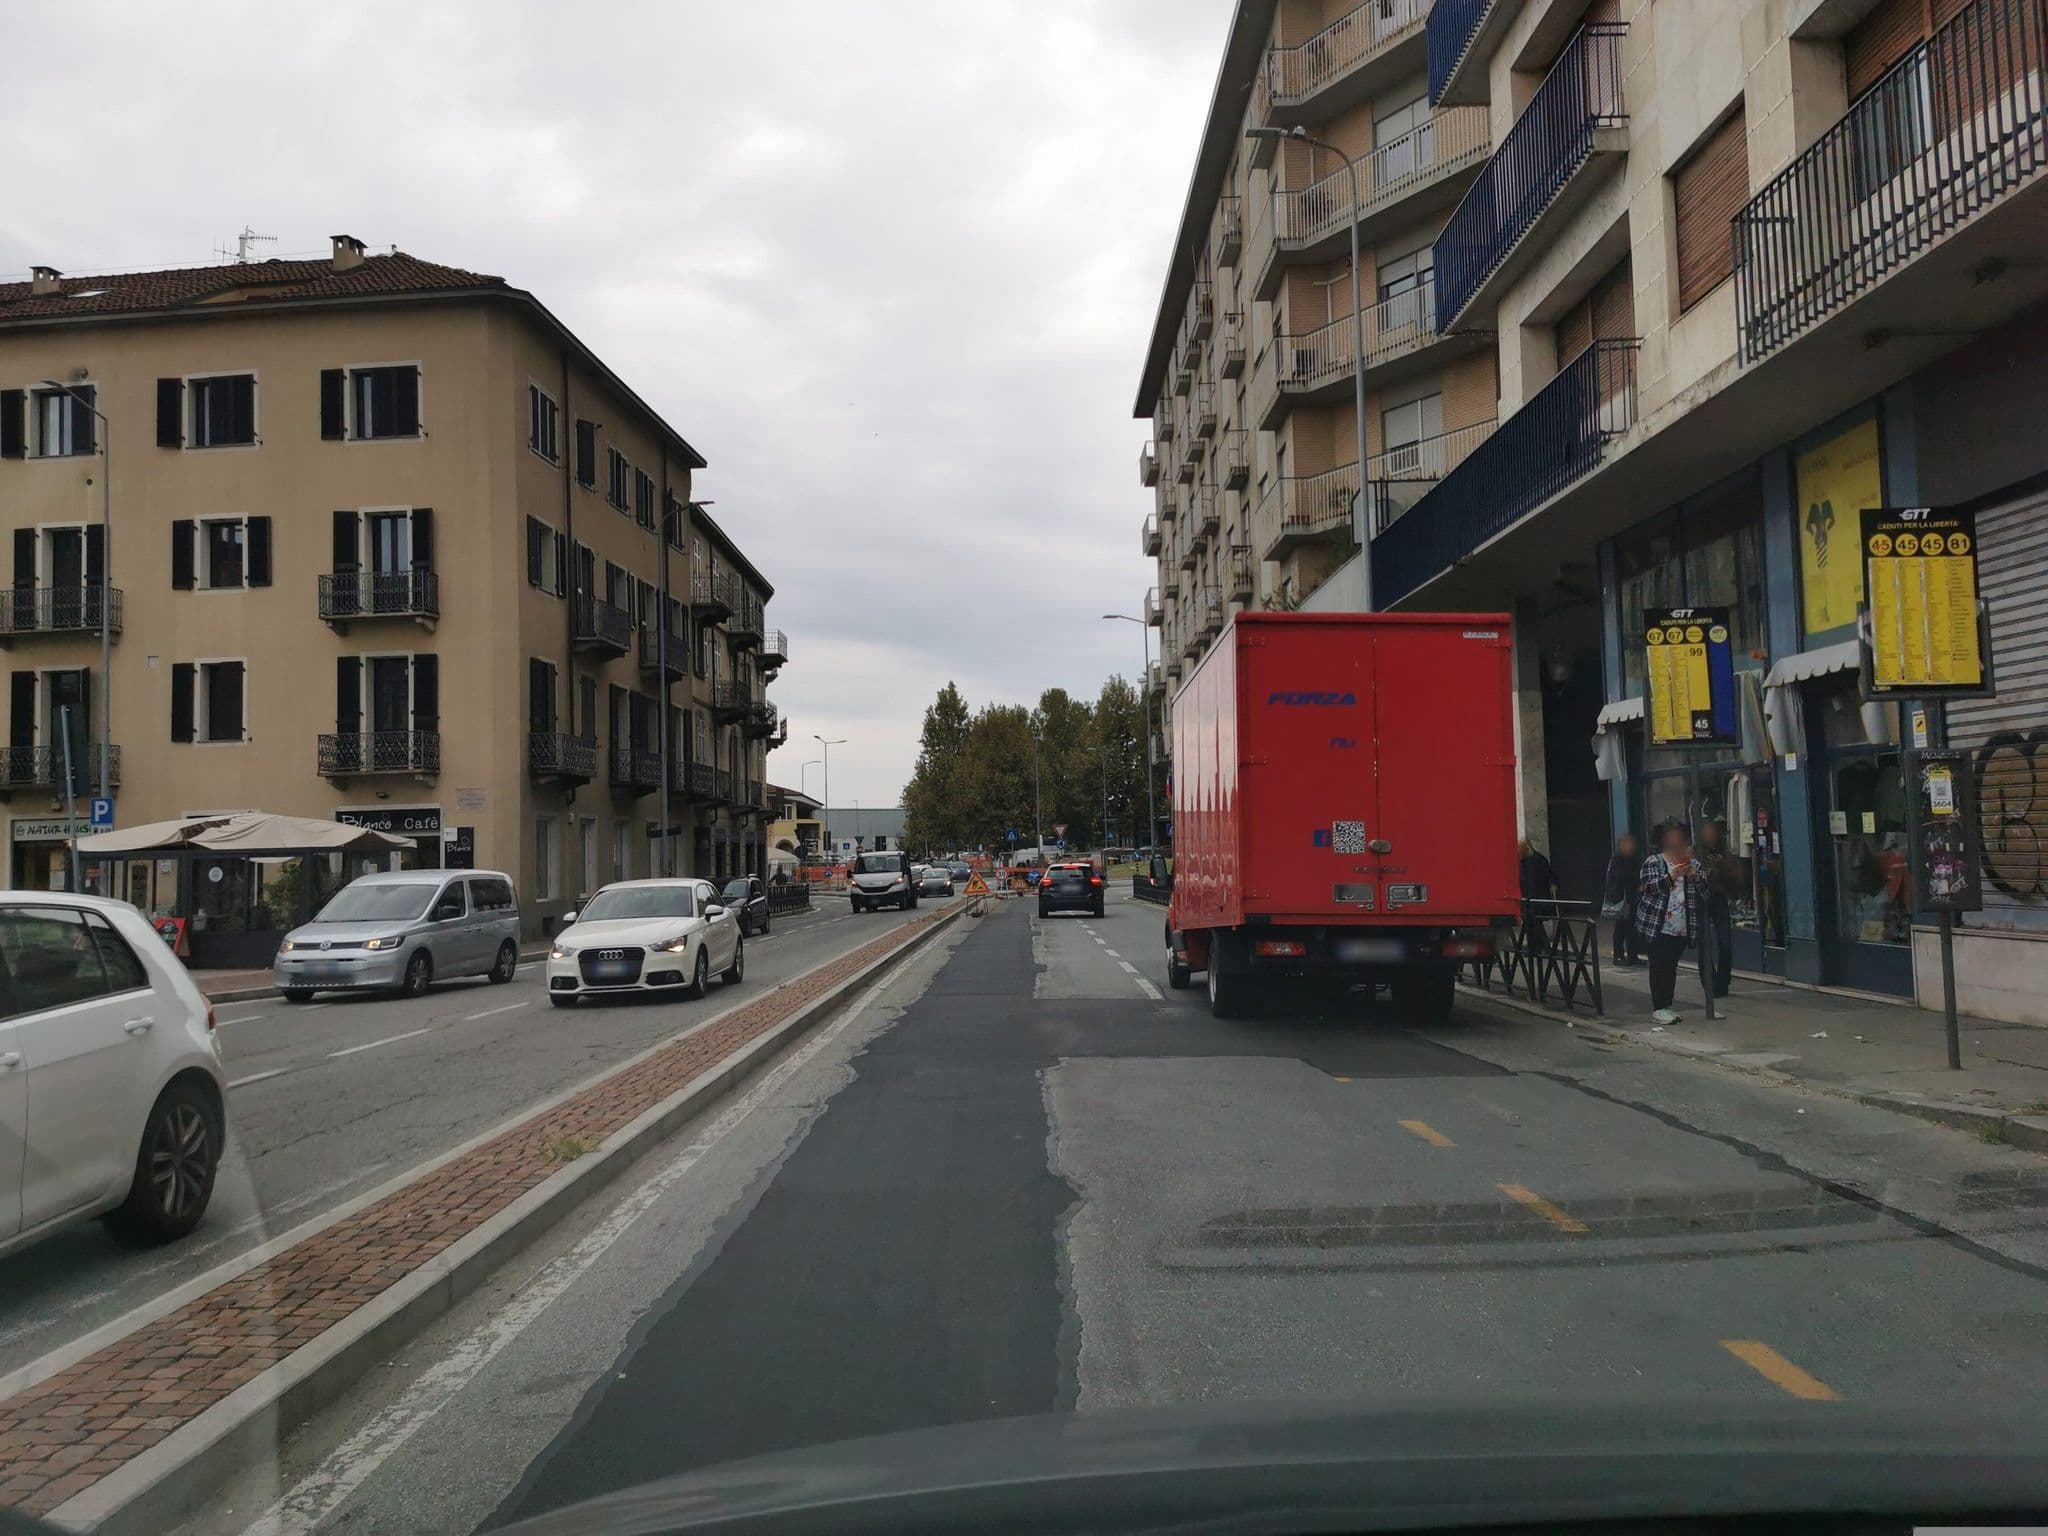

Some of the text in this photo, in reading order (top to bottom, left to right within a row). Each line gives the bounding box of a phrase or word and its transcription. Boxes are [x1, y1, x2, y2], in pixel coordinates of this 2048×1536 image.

[1901, 508, 1931, 520] GTT
[1898, 539, 1916, 550] 45
[1923, 539, 1942, 550] 45
[1950, 538, 1967, 549] 81
[1670, 609, 1694, 618] GTT
[1648, 632, 1661, 640] 67
[1668, 631, 1681, 640] 67
[1689, 647, 1703, 656] 99
[1267, 692, 1356, 705] FORZA
[1695, 719, 1709, 729] 45
[94, 800, 109, 822] P
[341, 815, 392, 830] Blanco
[27, 826, 61, 835] NATUR
[63, 824, 91, 835] HUS
